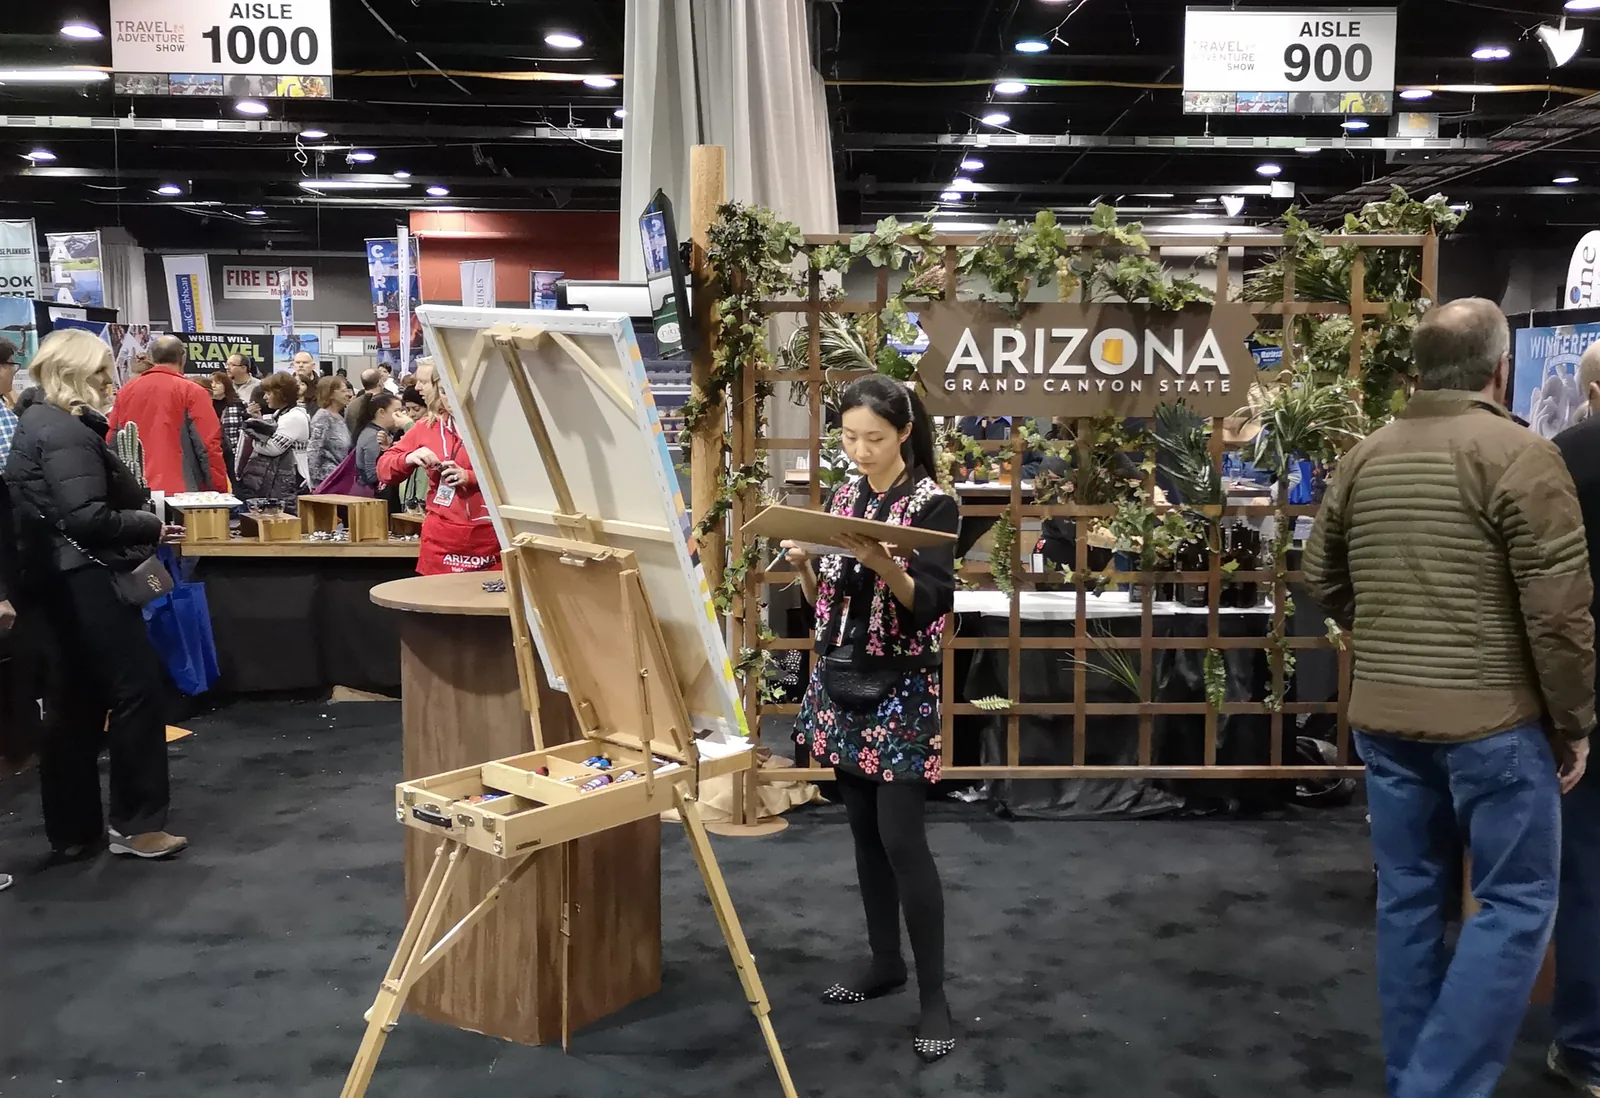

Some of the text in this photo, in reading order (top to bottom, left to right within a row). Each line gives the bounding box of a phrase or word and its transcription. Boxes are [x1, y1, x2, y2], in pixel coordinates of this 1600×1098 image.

[229, 2, 292, 20] AISLE
[116, 20, 172, 33] TRAVEL
[1299, 21, 1361, 38] AISLE
[117, 33, 185, 43] ADVENTURE
[156, 44, 185, 52] SHOW
[202, 25, 318, 65] 1000
[1227, 62, 1255, 71] SHOW
[1283, 43, 1372, 82] 900
[226, 269, 261, 286] FIRE
[292, 288, 309, 297] obby
[188, 335, 224, 343] WHERE
[944, 326, 1231, 376] ARIZONA
[195, 361, 220, 369] TAKE
[944, 379, 1231, 393] GRAND CANYON STATE
[443, 553, 498, 566] ARIZONA
